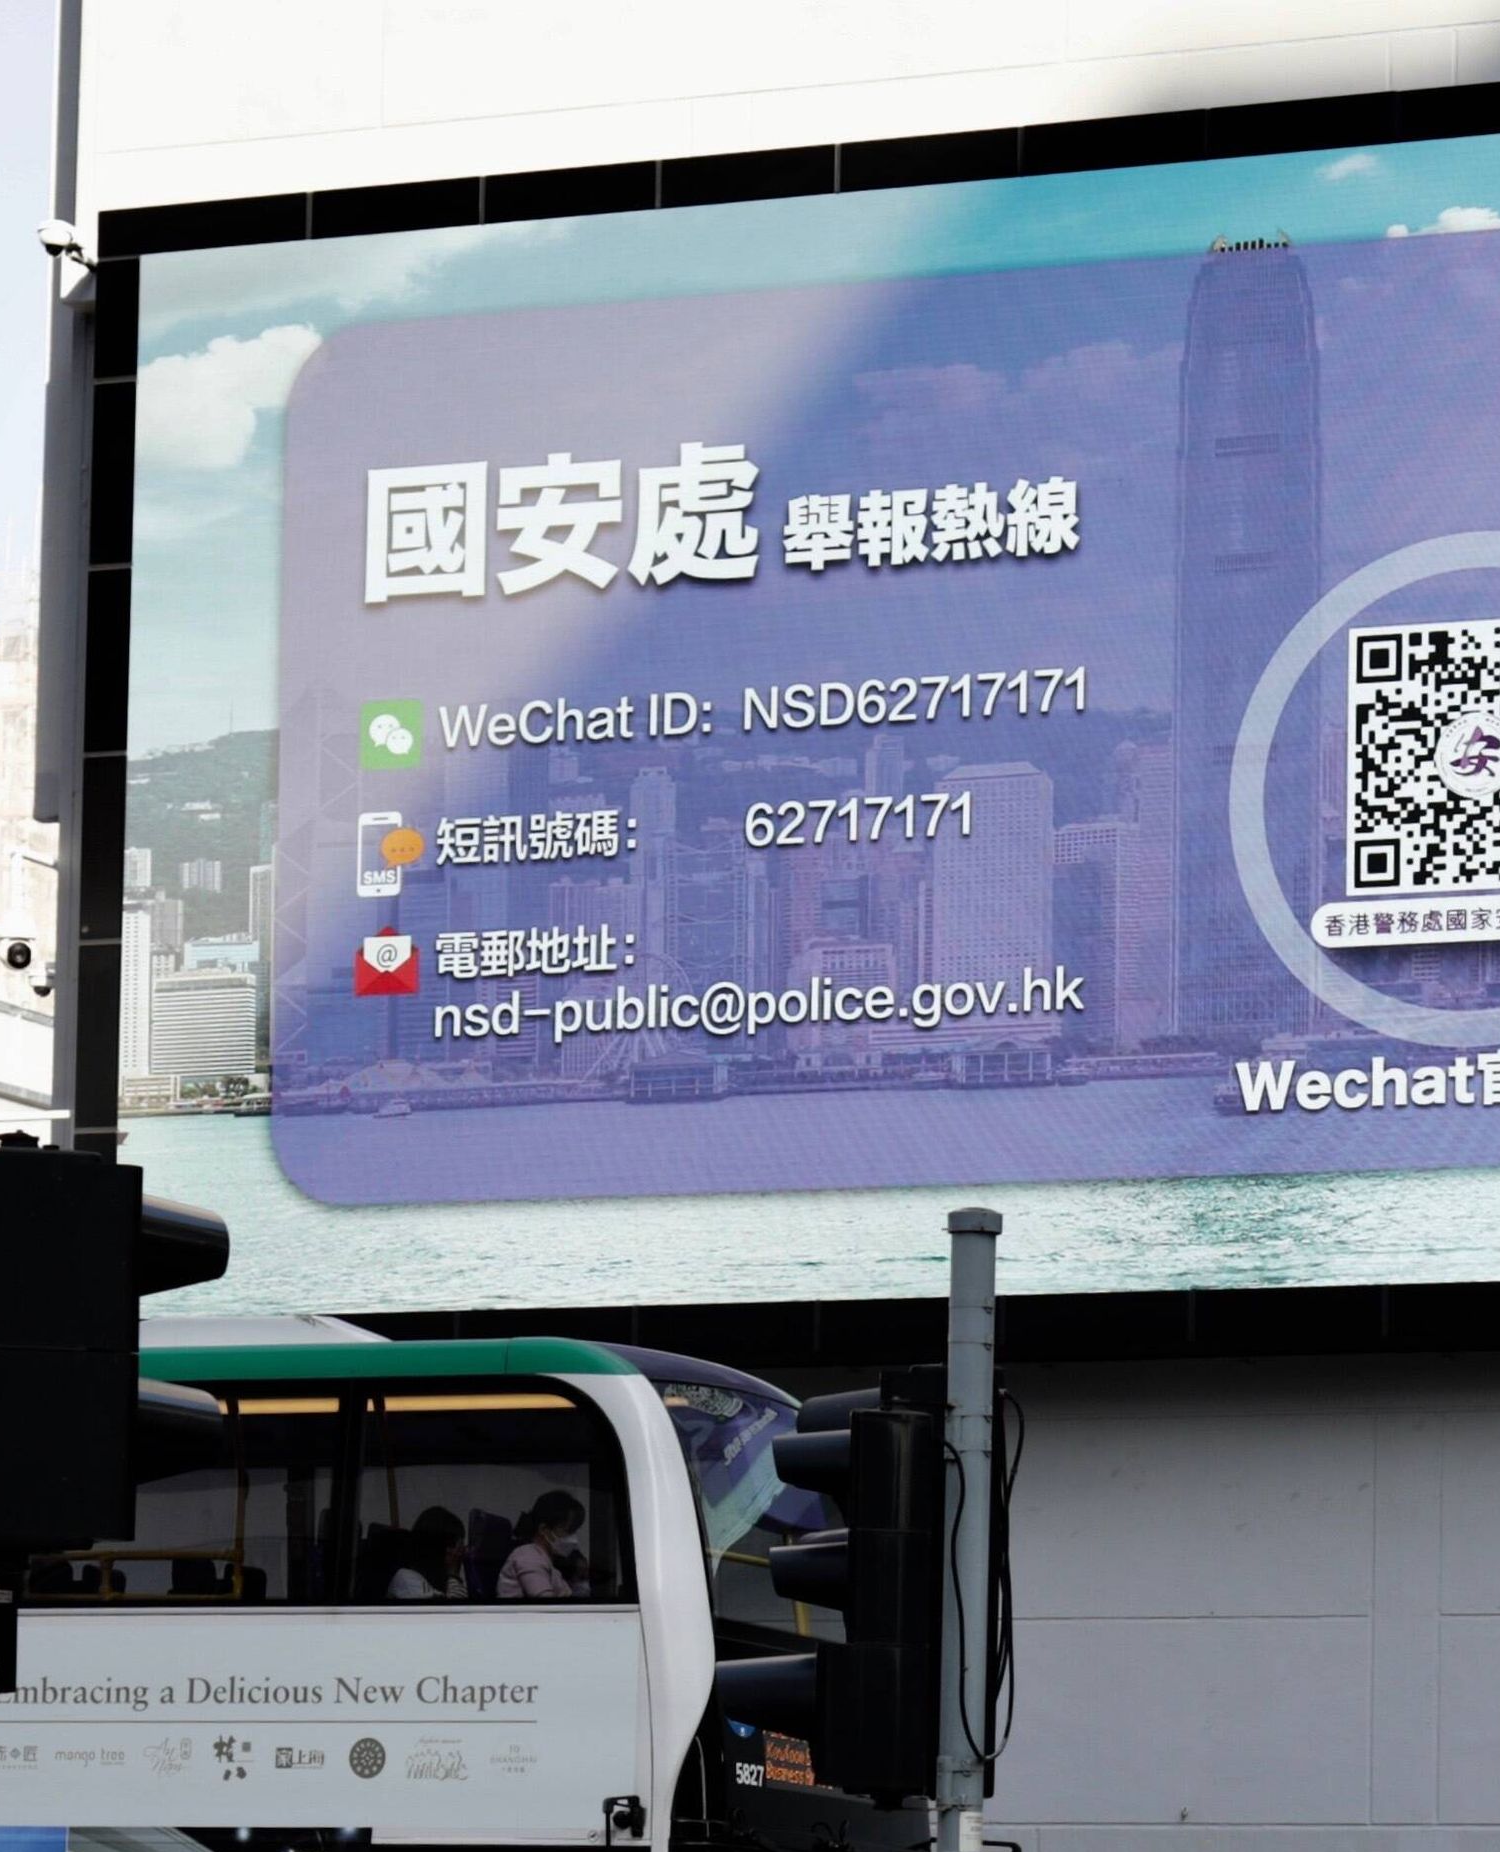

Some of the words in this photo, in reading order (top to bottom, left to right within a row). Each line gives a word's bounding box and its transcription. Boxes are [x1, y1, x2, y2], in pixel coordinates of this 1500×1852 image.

[366, 442, 759, 603] 國安處
[784, 475, 1080, 570] 舉報熱線
[439, 700, 633, 748] WeChat
[649, 692, 713, 737] ID:
[743, 666, 1087, 732] NSD62717171
[436, 808, 639, 866] 短訊號碼：
[745, 790, 973, 847] 62717171
[362, 868, 397, 887] SMS
[435, 924, 636, 979] 電郵地址：
[434, 965, 1085, 1042] nsd-public@police.gov.hk
[159, 1683, 175, 1704] a
[187, 1675, 322, 1705] Delicious
[334, 1676, 405, 1705] New
[416, 1675, 539, 1711] Chapter
[54, 1749, 96, 1768] mango
[735, 1762, 764, 1787] 5827
